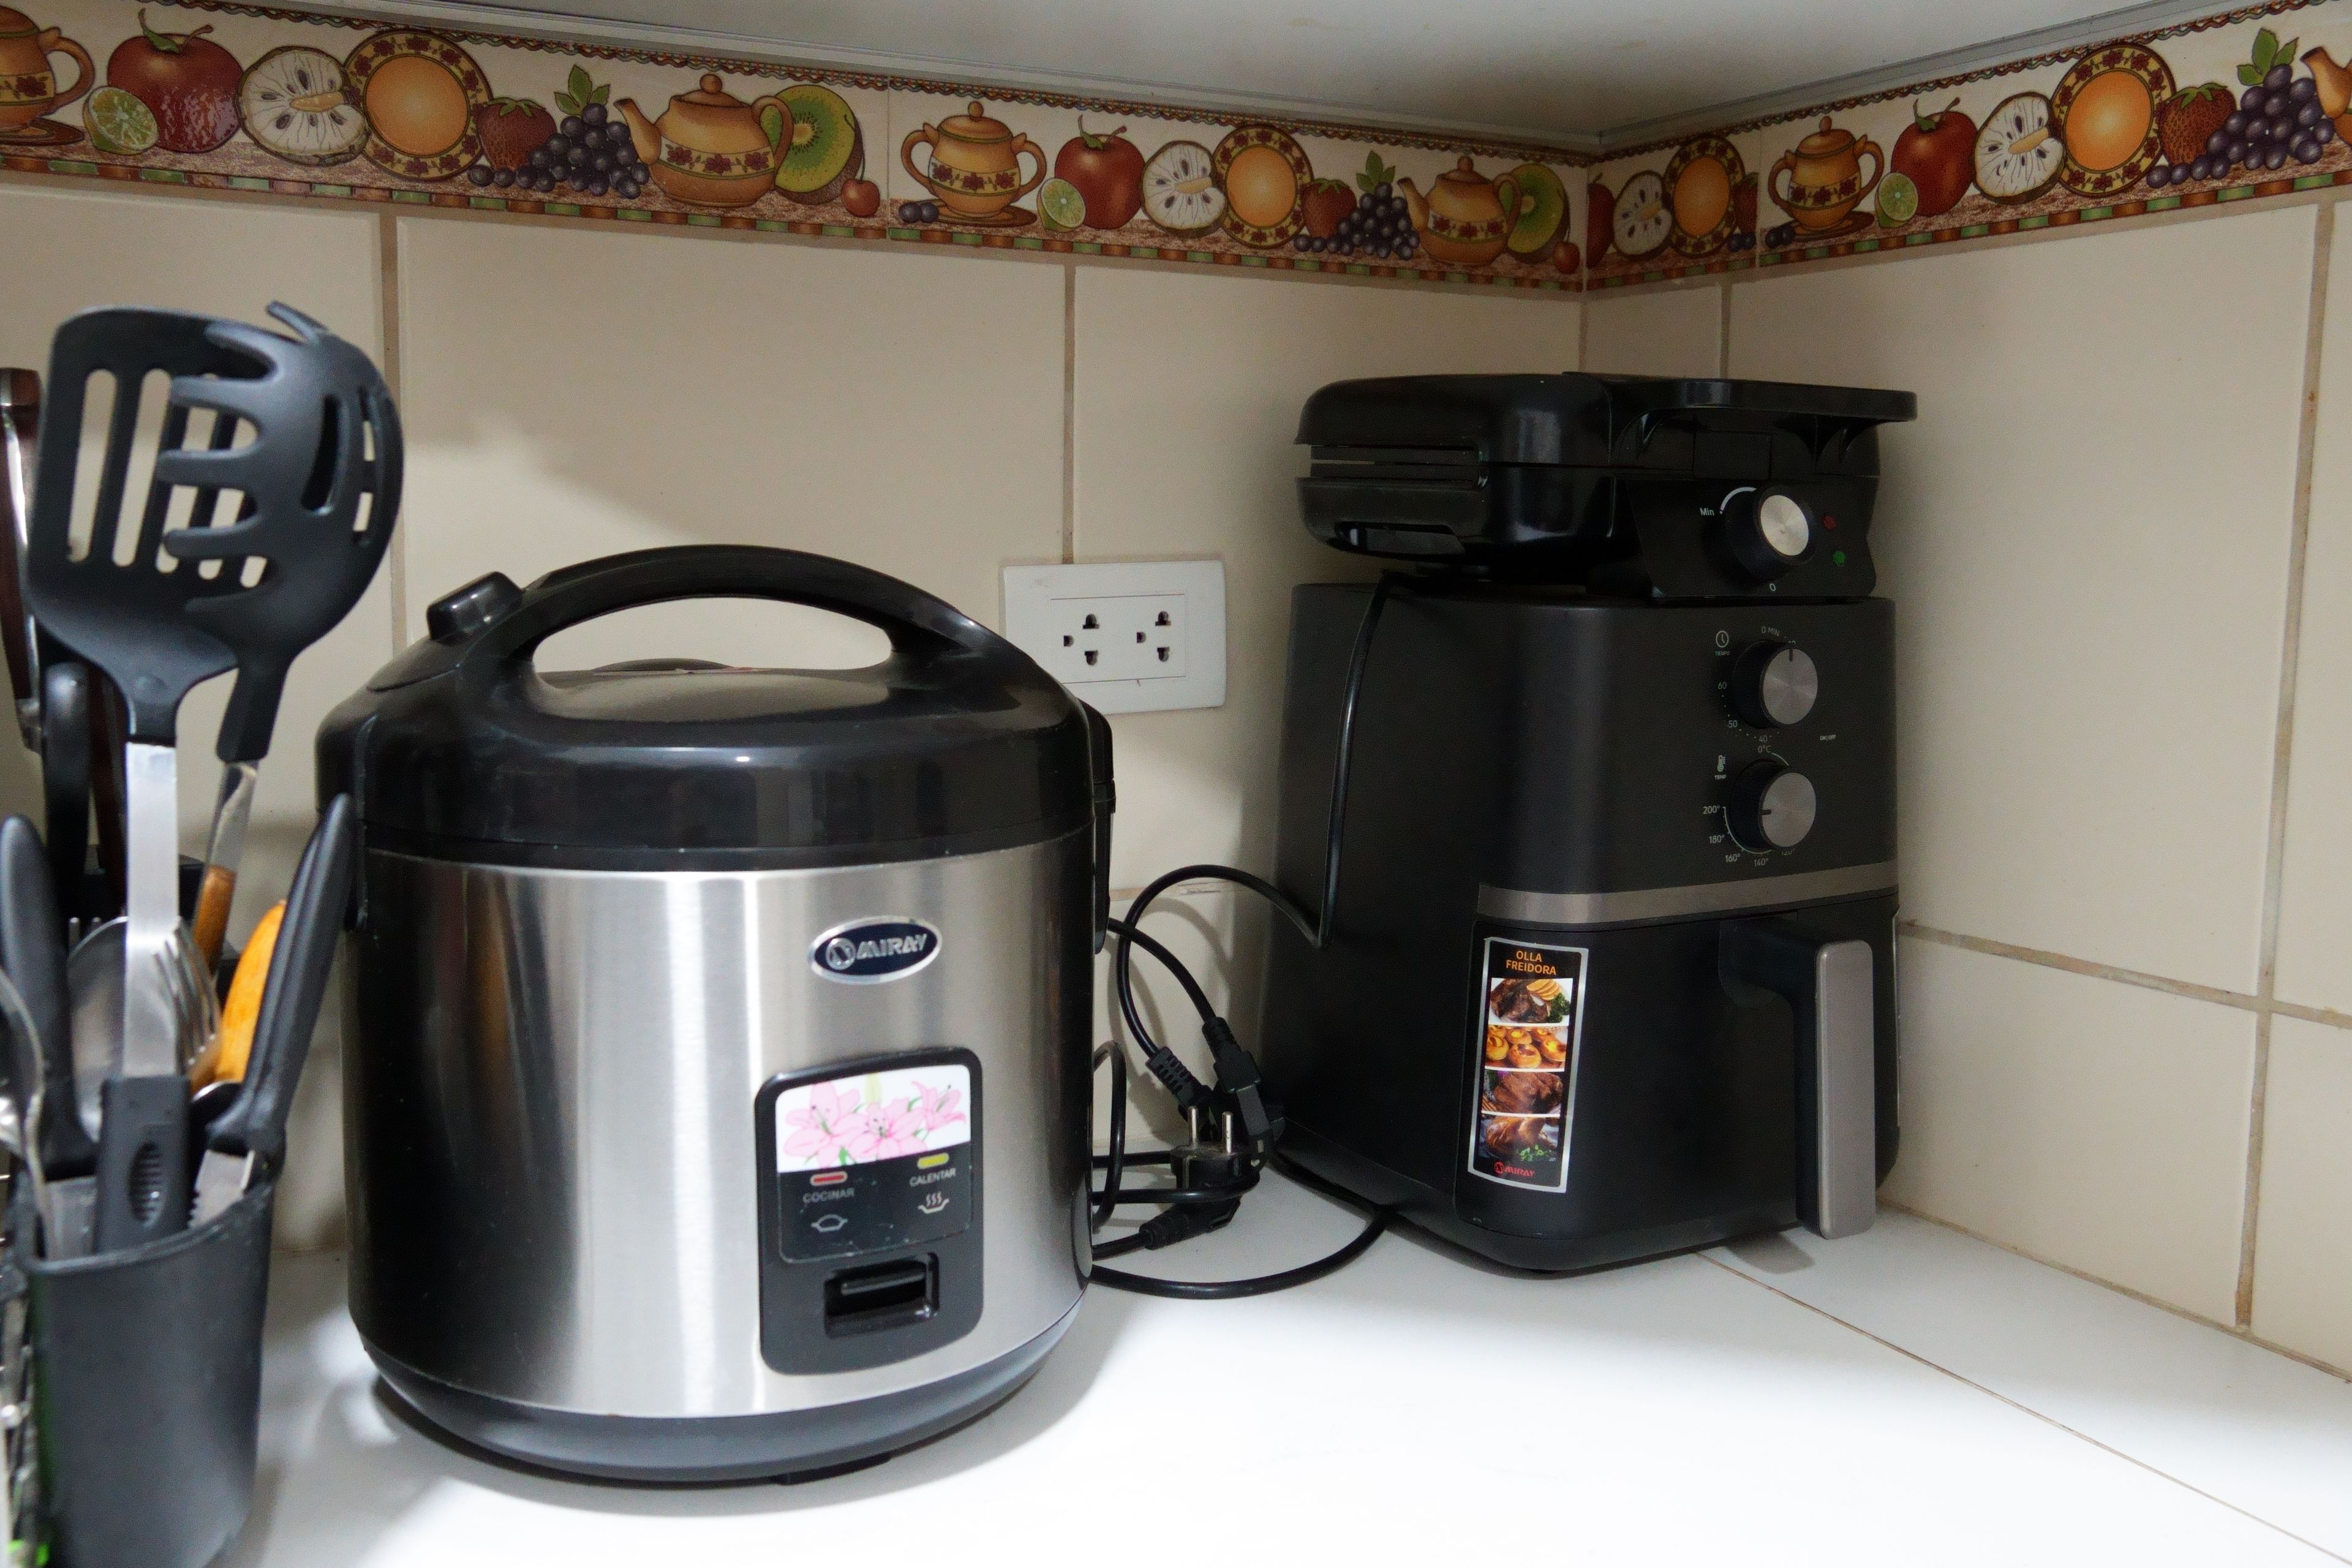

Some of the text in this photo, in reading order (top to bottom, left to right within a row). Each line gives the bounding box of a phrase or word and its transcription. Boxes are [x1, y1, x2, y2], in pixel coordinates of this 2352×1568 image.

[1700, 507, 1715, 516] Min
[1768, 627, 1779, 636] MIN
[1717, 681, 1727, 690] 60
[1728, 720, 1738, 728] 50
[1516, 951, 1542, 963] OLLA
[1506, 959, 1556, 975] FREIDORA
[910, 1167, 957, 1187] CALENTAR
[1505, 1166, 1534, 1177] MIRAY
[802, 1187, 854, 1204] COCINAR
